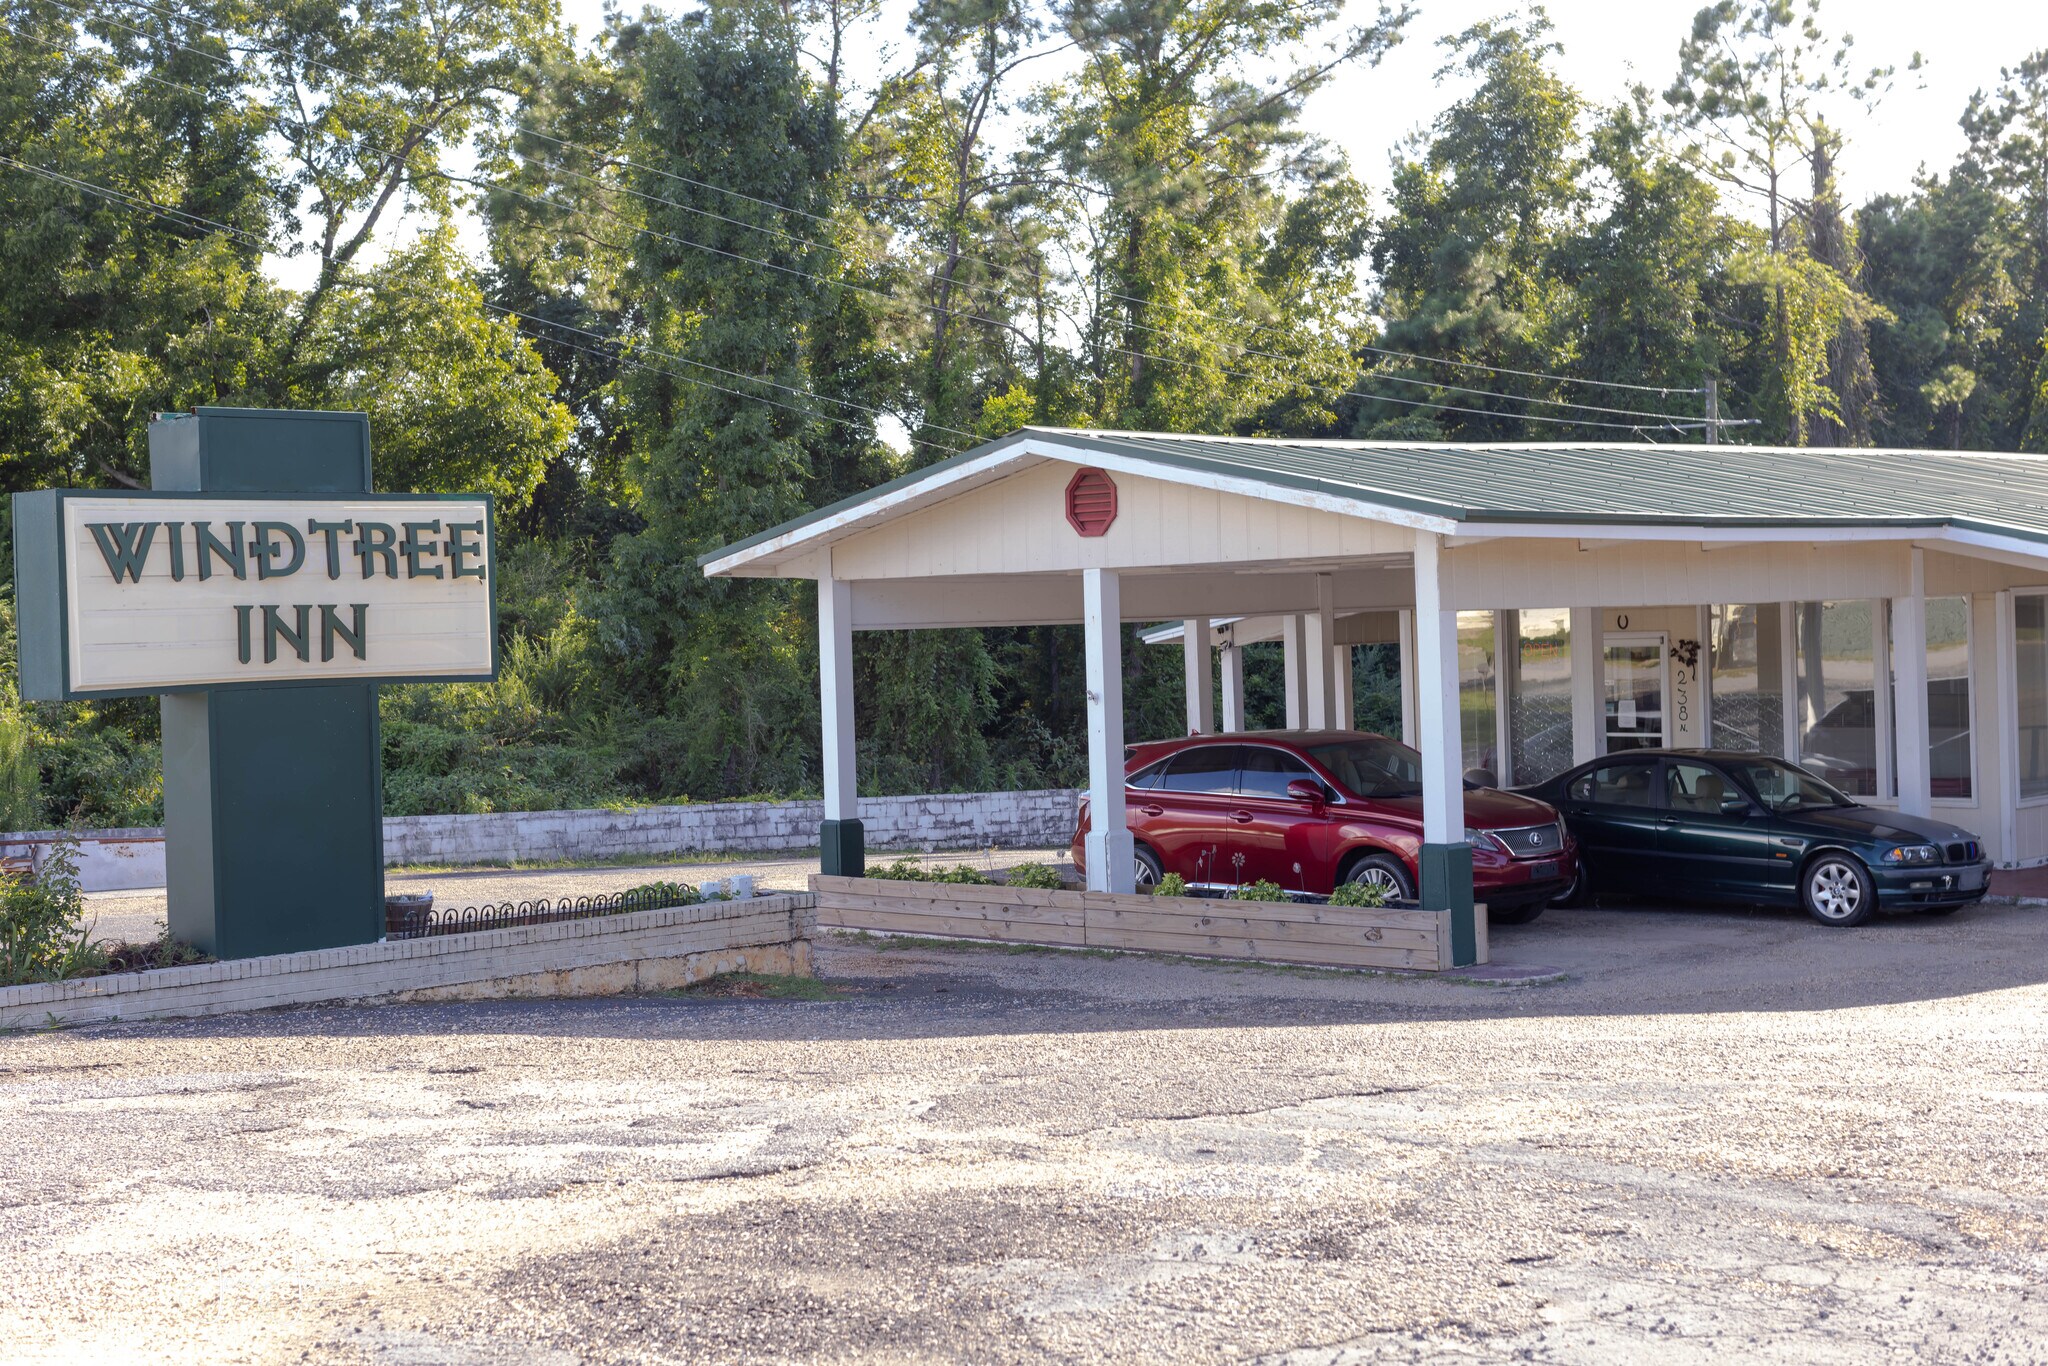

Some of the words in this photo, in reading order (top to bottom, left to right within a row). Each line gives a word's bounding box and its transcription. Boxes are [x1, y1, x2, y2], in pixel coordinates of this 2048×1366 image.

[84, 518, 487, 584] WINDTREE
[233, 603, 370, 665] INN
[1523, 643, 1559, 657] OPEN
[1677, 670, 1689, 721] 238
